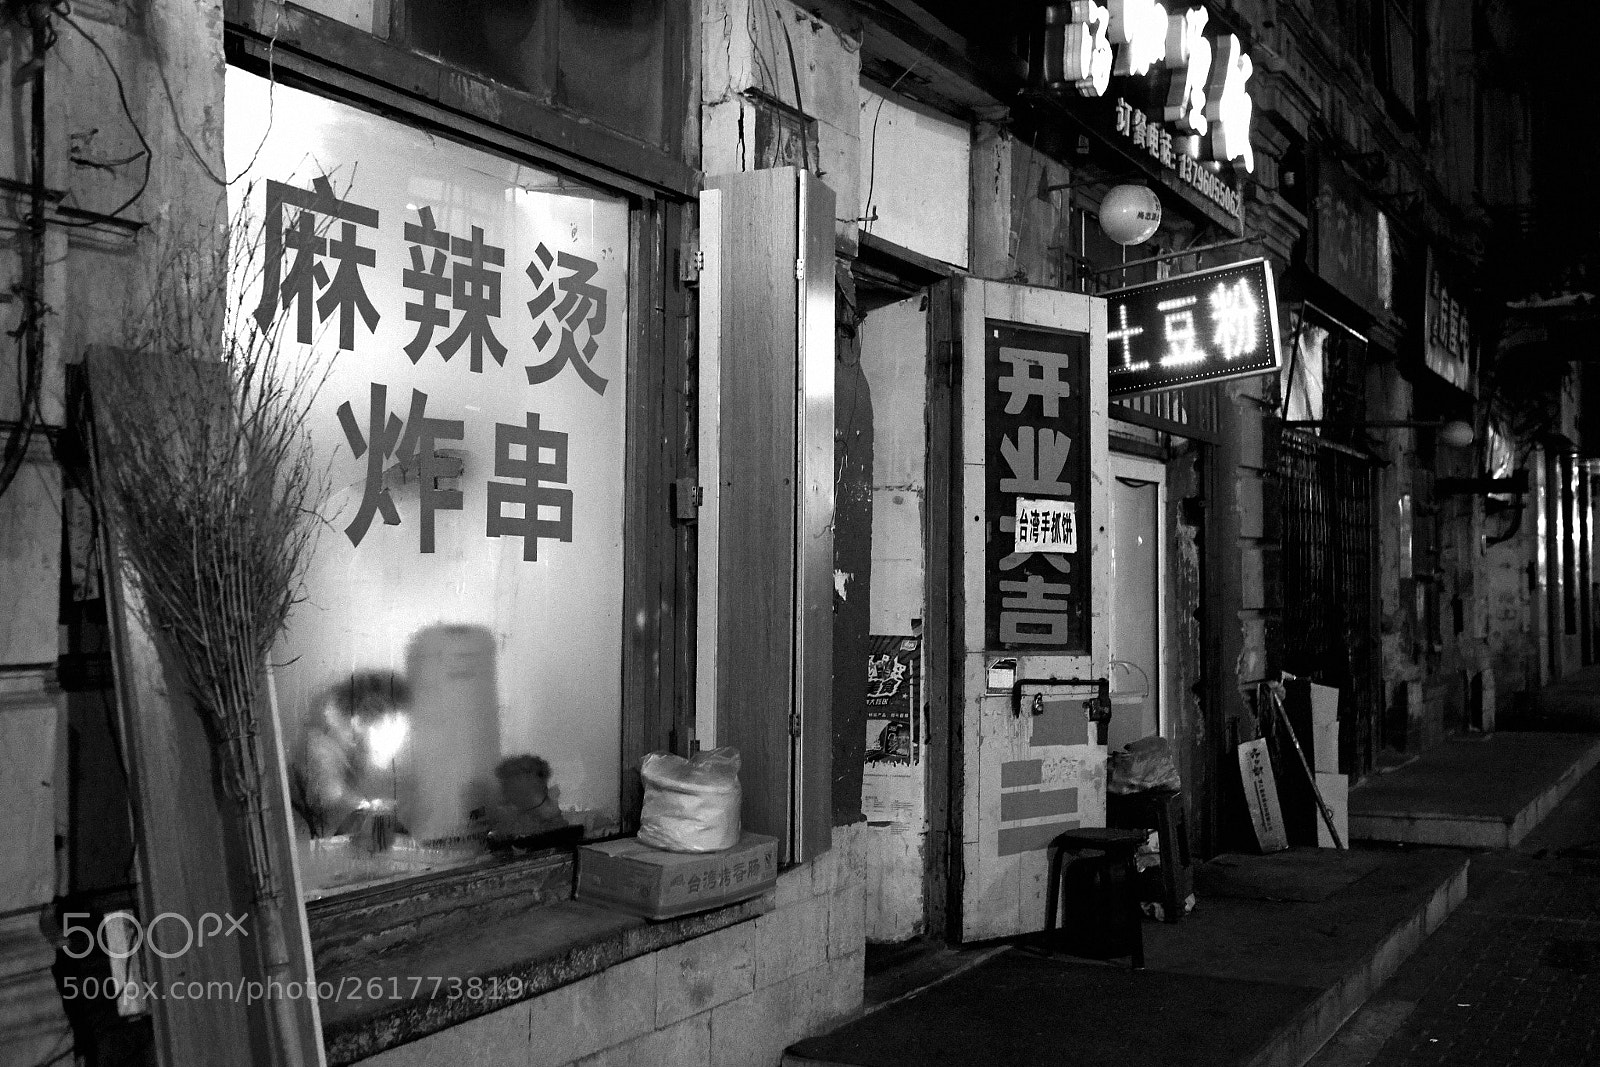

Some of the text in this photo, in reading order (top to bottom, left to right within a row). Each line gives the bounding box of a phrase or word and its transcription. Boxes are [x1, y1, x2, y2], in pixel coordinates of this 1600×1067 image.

[1178, 153, 1241, 218] 13796055062
[254, 176, 608, 396] 麻辣烫
[1108, 277, 1258, 371] 土豆粉
[337, 383, 574, 562] 炸串
[1019, 508, 1073, 545] 台湾手抓饼
[687, 858, 761, 894] 台湾烤香肠
